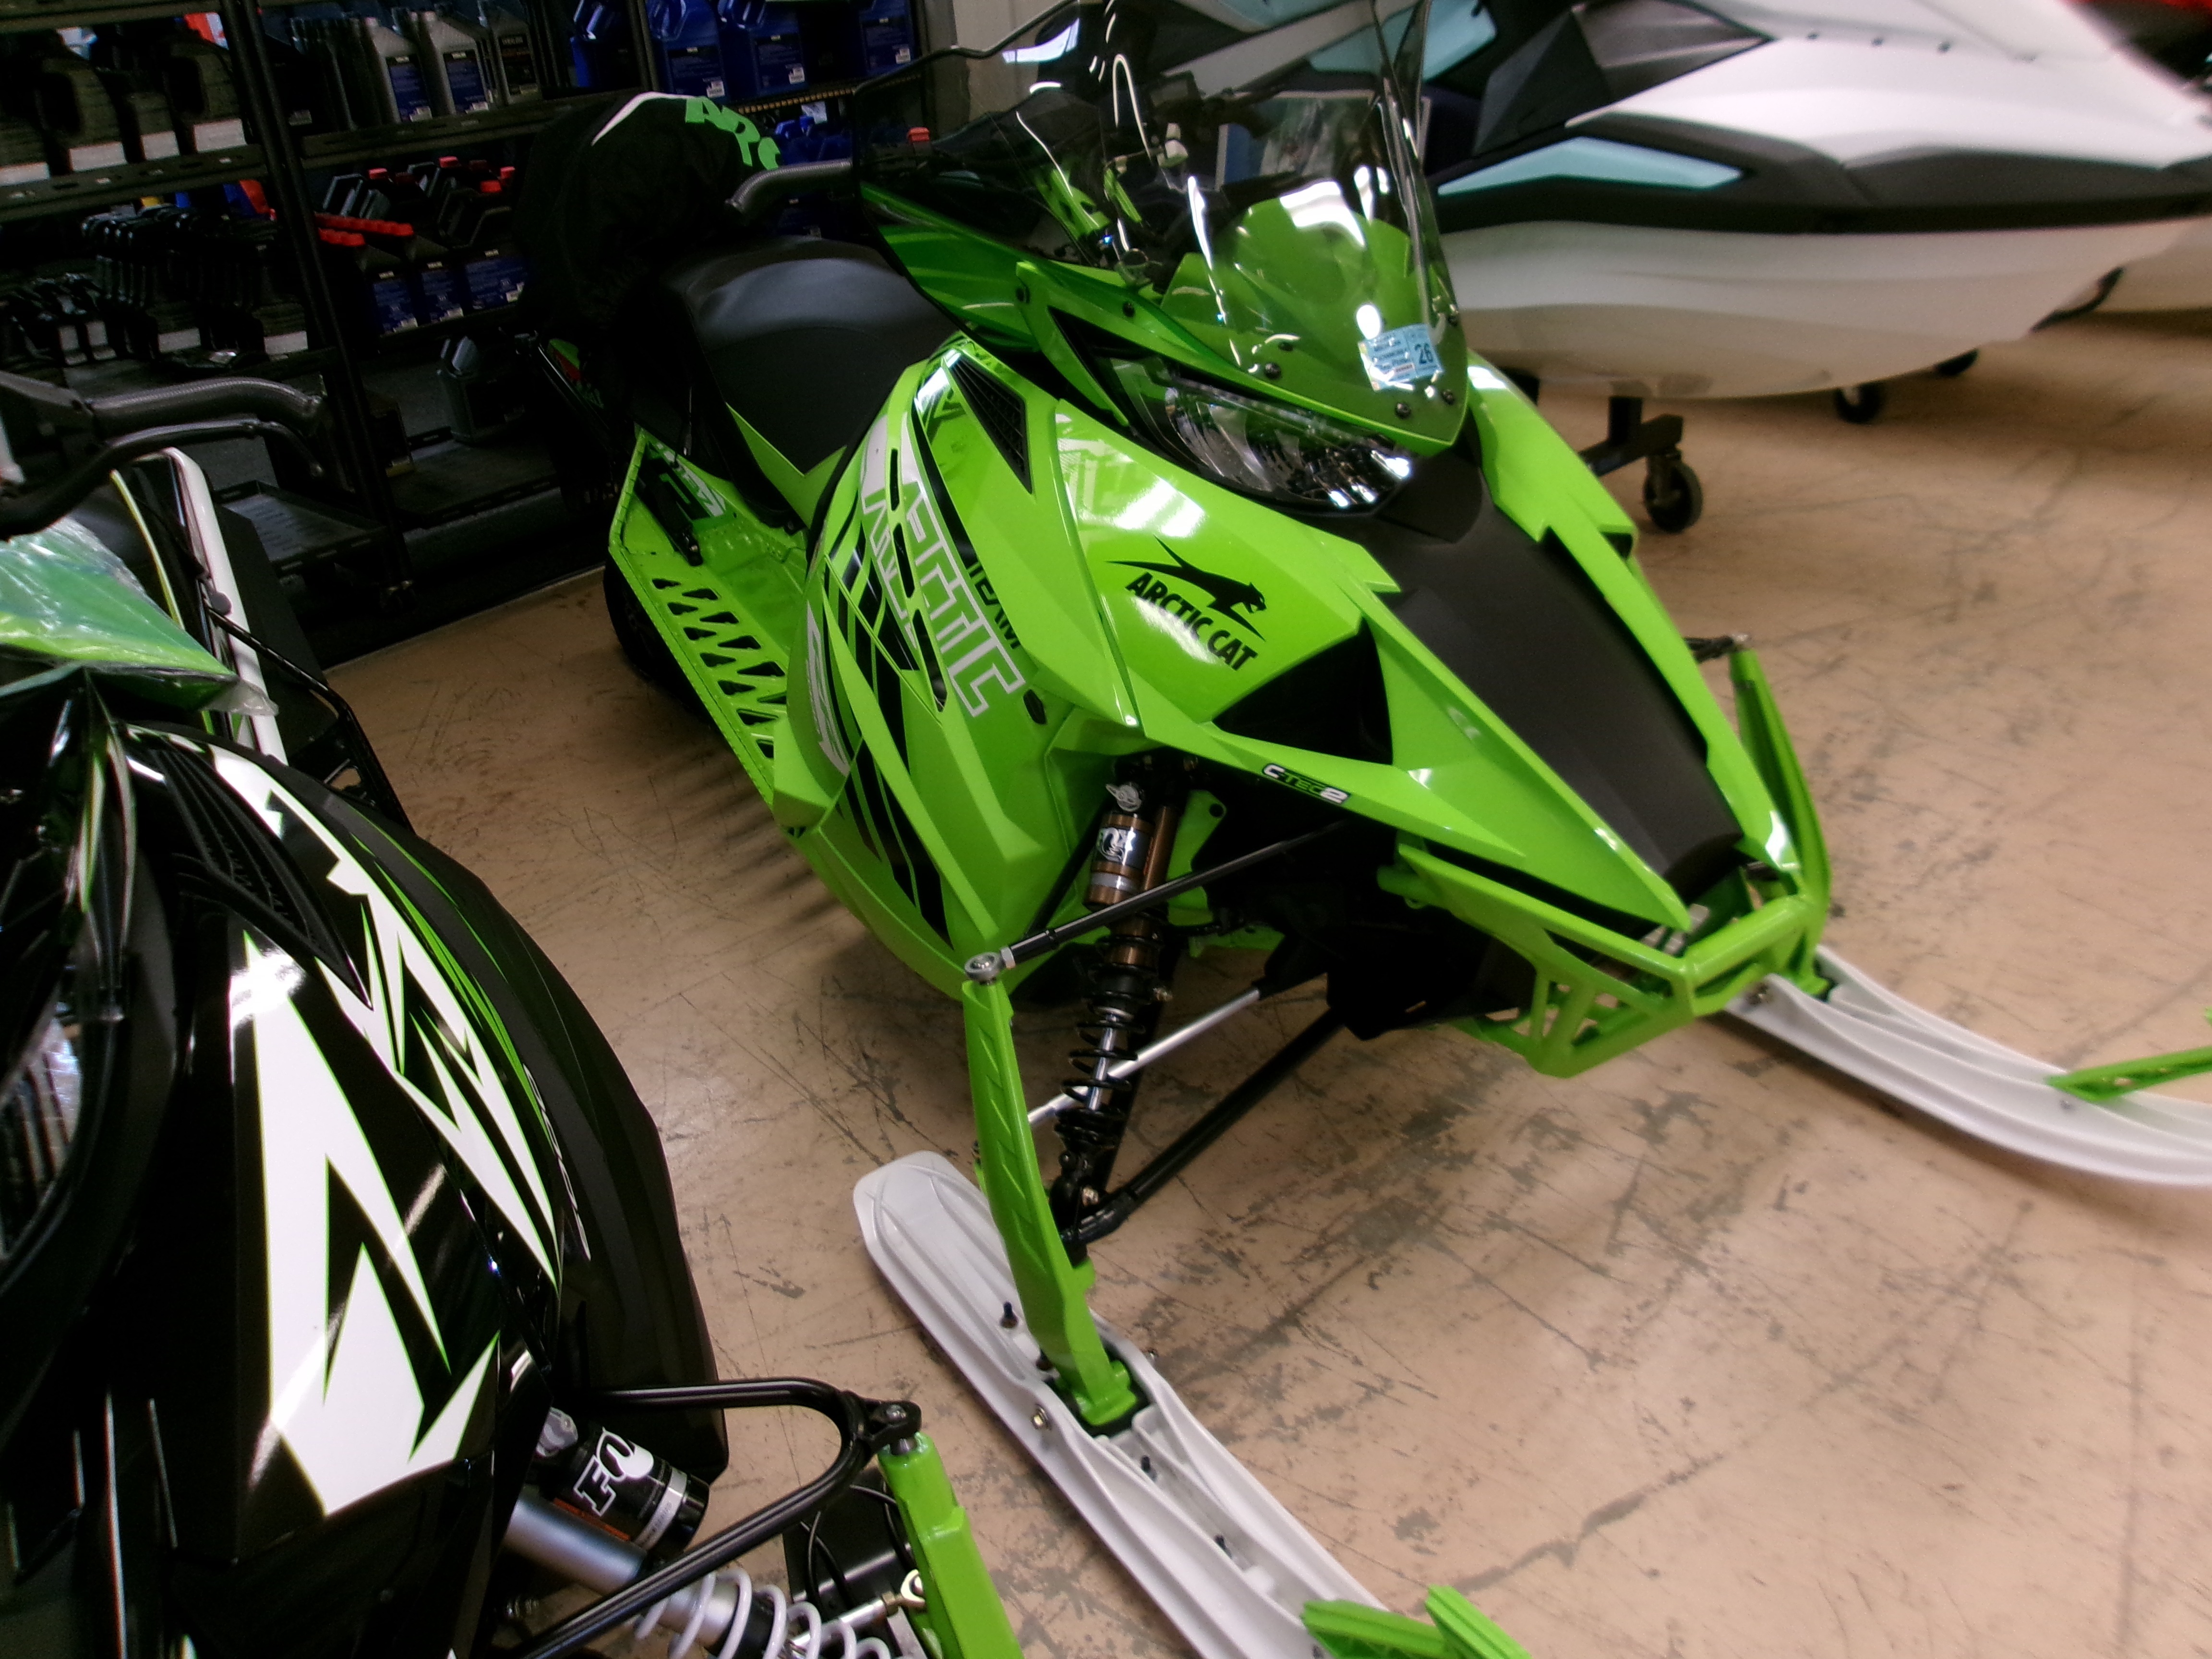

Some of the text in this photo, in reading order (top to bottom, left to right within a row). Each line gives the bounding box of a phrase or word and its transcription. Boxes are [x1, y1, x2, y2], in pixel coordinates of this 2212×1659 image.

[1125, 572, 1258, 671] ARCTIC CAT
[573, 1427, 654, 1517] FO
